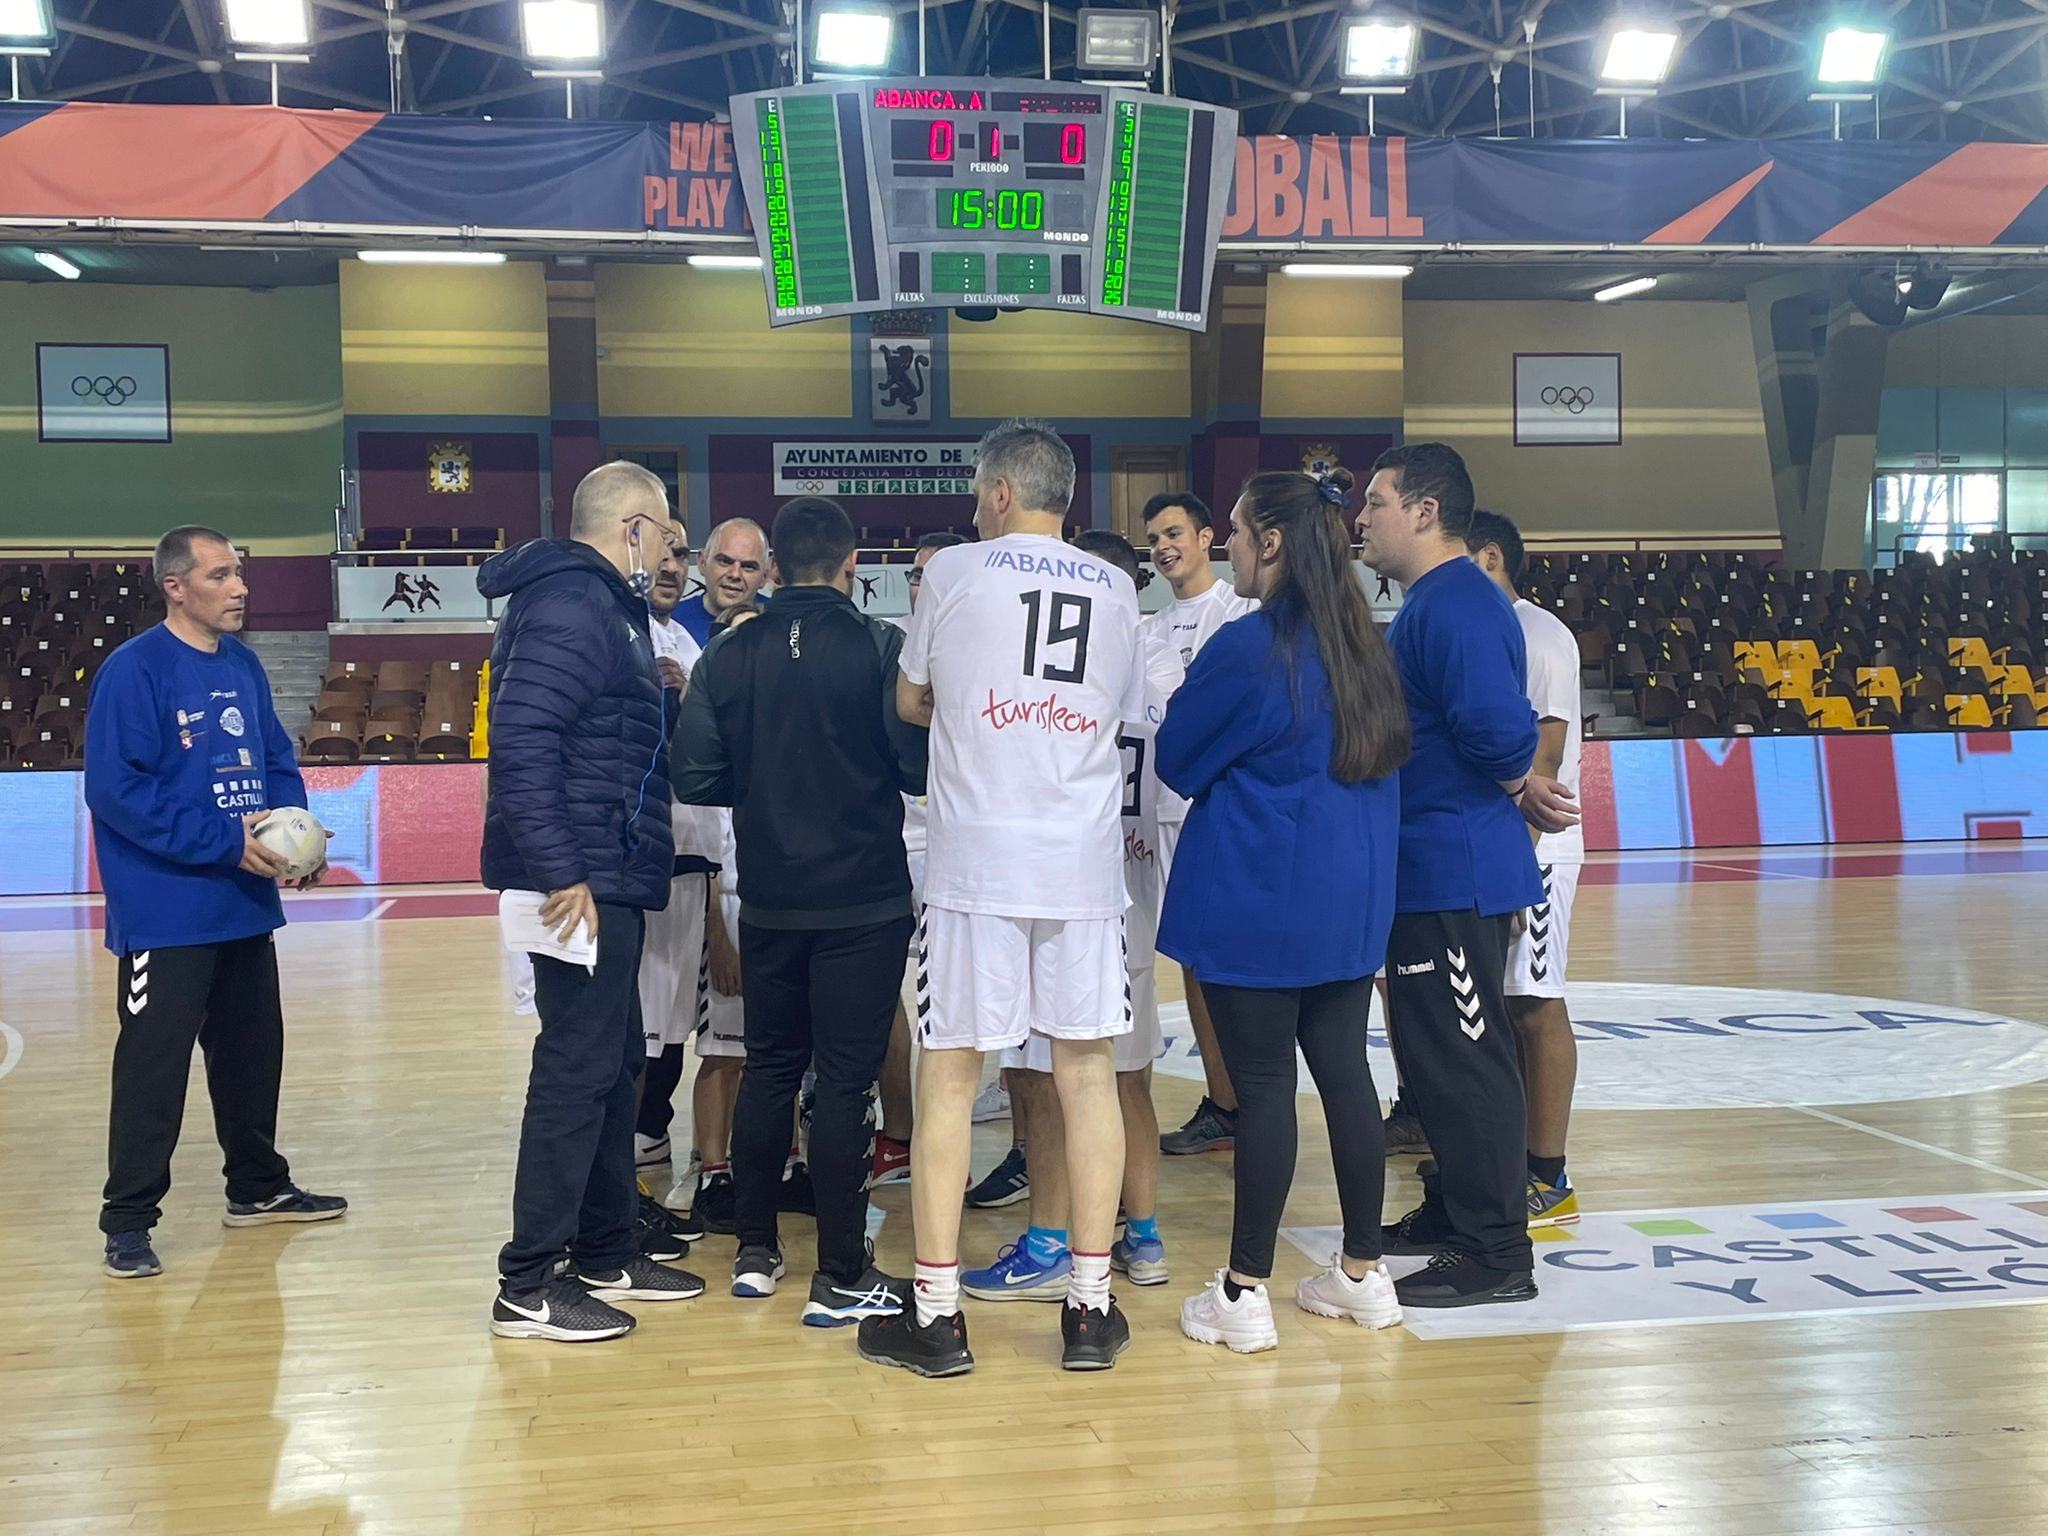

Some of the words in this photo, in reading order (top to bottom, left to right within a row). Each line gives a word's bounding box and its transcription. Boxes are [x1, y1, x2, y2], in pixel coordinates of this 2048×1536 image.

[873, 88, 983, 111] ABANCA.A
[768, 114, 778, 128] 5
[1124, 118, 1134, 133] 3
[761, 130, 779, 145] 13
[929, 120, 953, 161] 0
[990, 127, 999, 157] 1
[1060, 123, 1084, 164] 0
[1123, 134, 1133, 148] 4
[669, 121, 733, 172] WE
[762, 147, 780, 161] 17
[1122, 149, 1131, 164] 6
[969, 162, 1010, 173] PERIODO
[1122, 166, 1131, 179] 7
[766, 179, 784, 193] 19
[1111, 180, 1129, 195] 10
[643, 175, 731, 228] PLAY
[768, 195, 786, 210] 20
[1110, 196, 1128, 211] 13
[952, 191, 1042, 230] 15:00
[770, 211, 787, 226] 23
[1109, 212, 1128, 227] 14
[771, 228, 789, 243] 24
[1043, 231, 1089, 242] MONDO
[1108, 227, 1126, 242] 15
[773, 243, 791, 258] 27
[1106, 243, 1125, 258] 17
[1104, 274, 1123, 289] 20
[778, 292, 796, 306] 65
[895, 292, 925, 302] FALTAS
[963, 294, 1020, 304] EXCLUSIONES
[1057, 295, 1086, 305] FALTAS
[776, 306, 823, 317] MONDO
[1156, 310, 1202, 322] MONDO
[785, 450, 927, 464] AYUNTAMIENTO
[940, 450, 962, 463] DE
[904, 469, 921, 478] DE
[936, 468, 973, 478] DEPO
[1019, 589, 1092, 684] 19
[1397, 959, 1436, 975] hummel
[1672, 1277, 1768, 1304] Y
